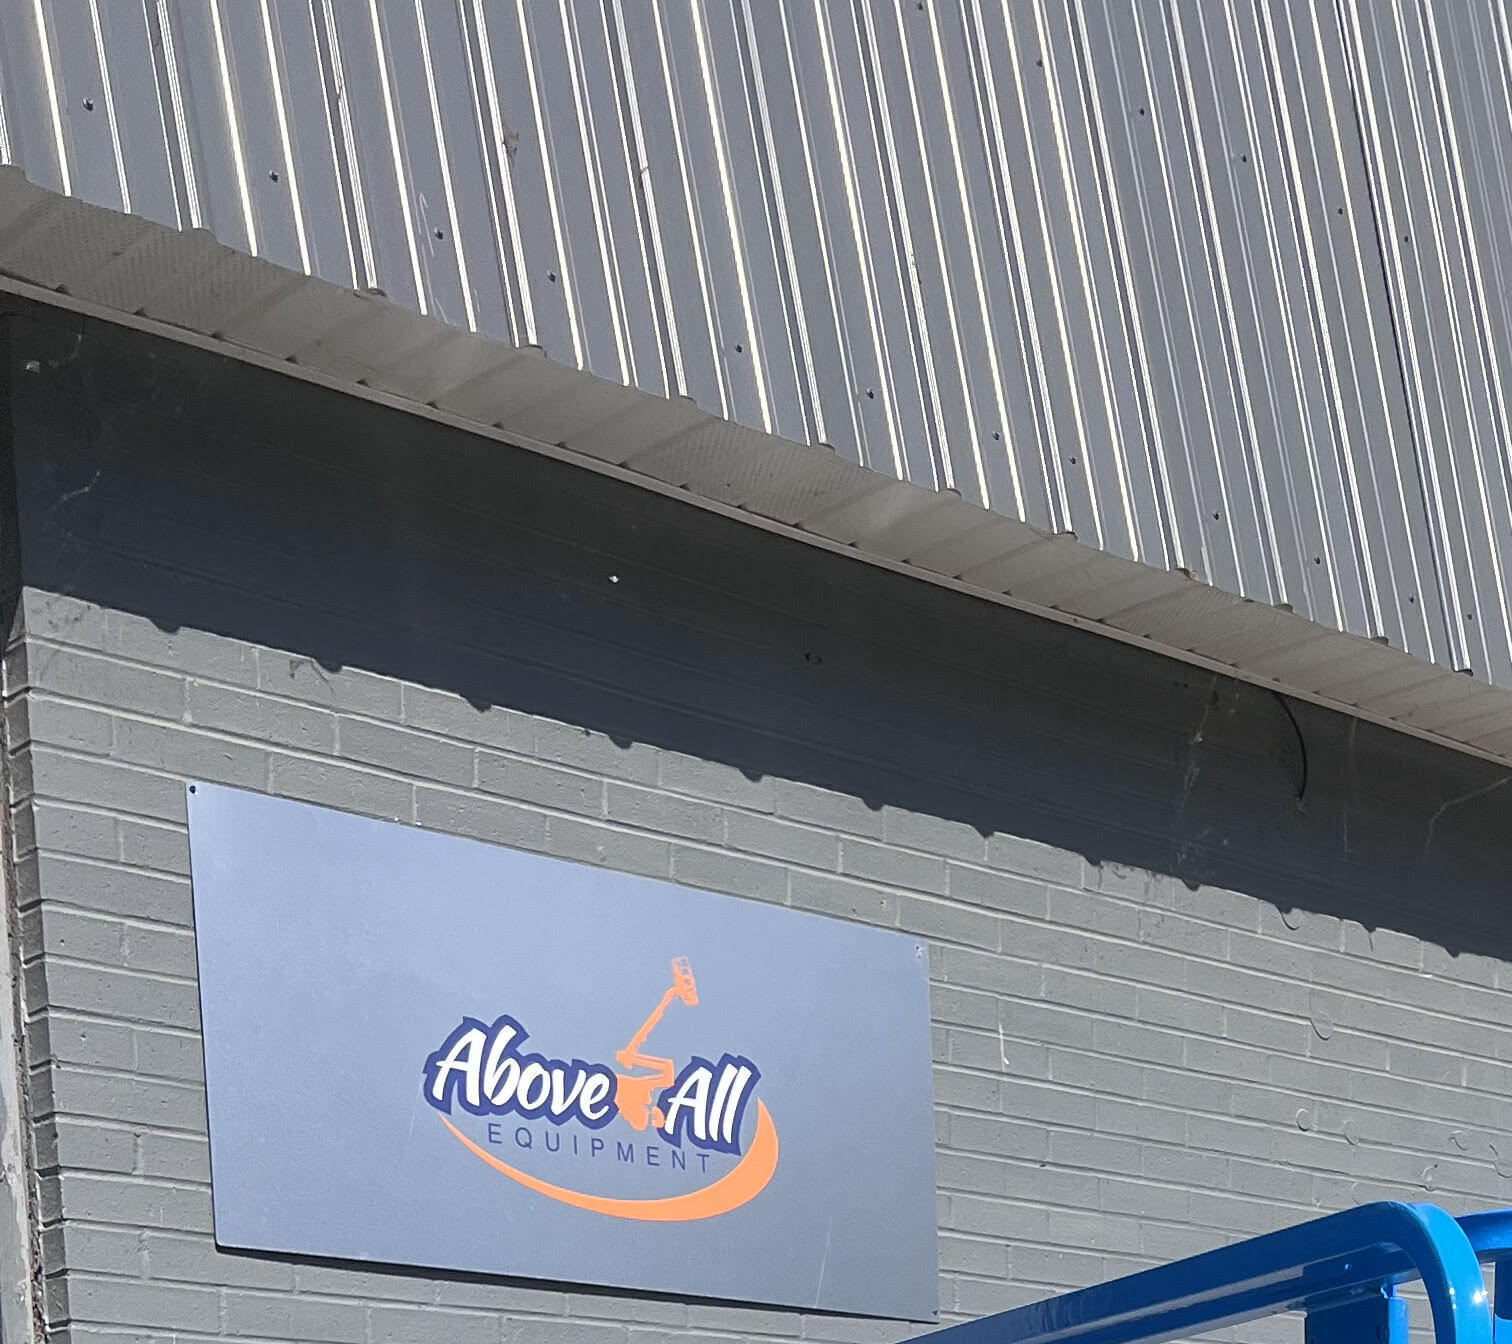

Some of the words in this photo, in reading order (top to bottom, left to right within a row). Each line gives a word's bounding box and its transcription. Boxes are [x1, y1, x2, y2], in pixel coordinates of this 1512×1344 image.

[431, 1024, 611, 1121] Above
[666, 1062, 753, 1143] All
[487, 1122, 712, 1173] EQUIPMENT
